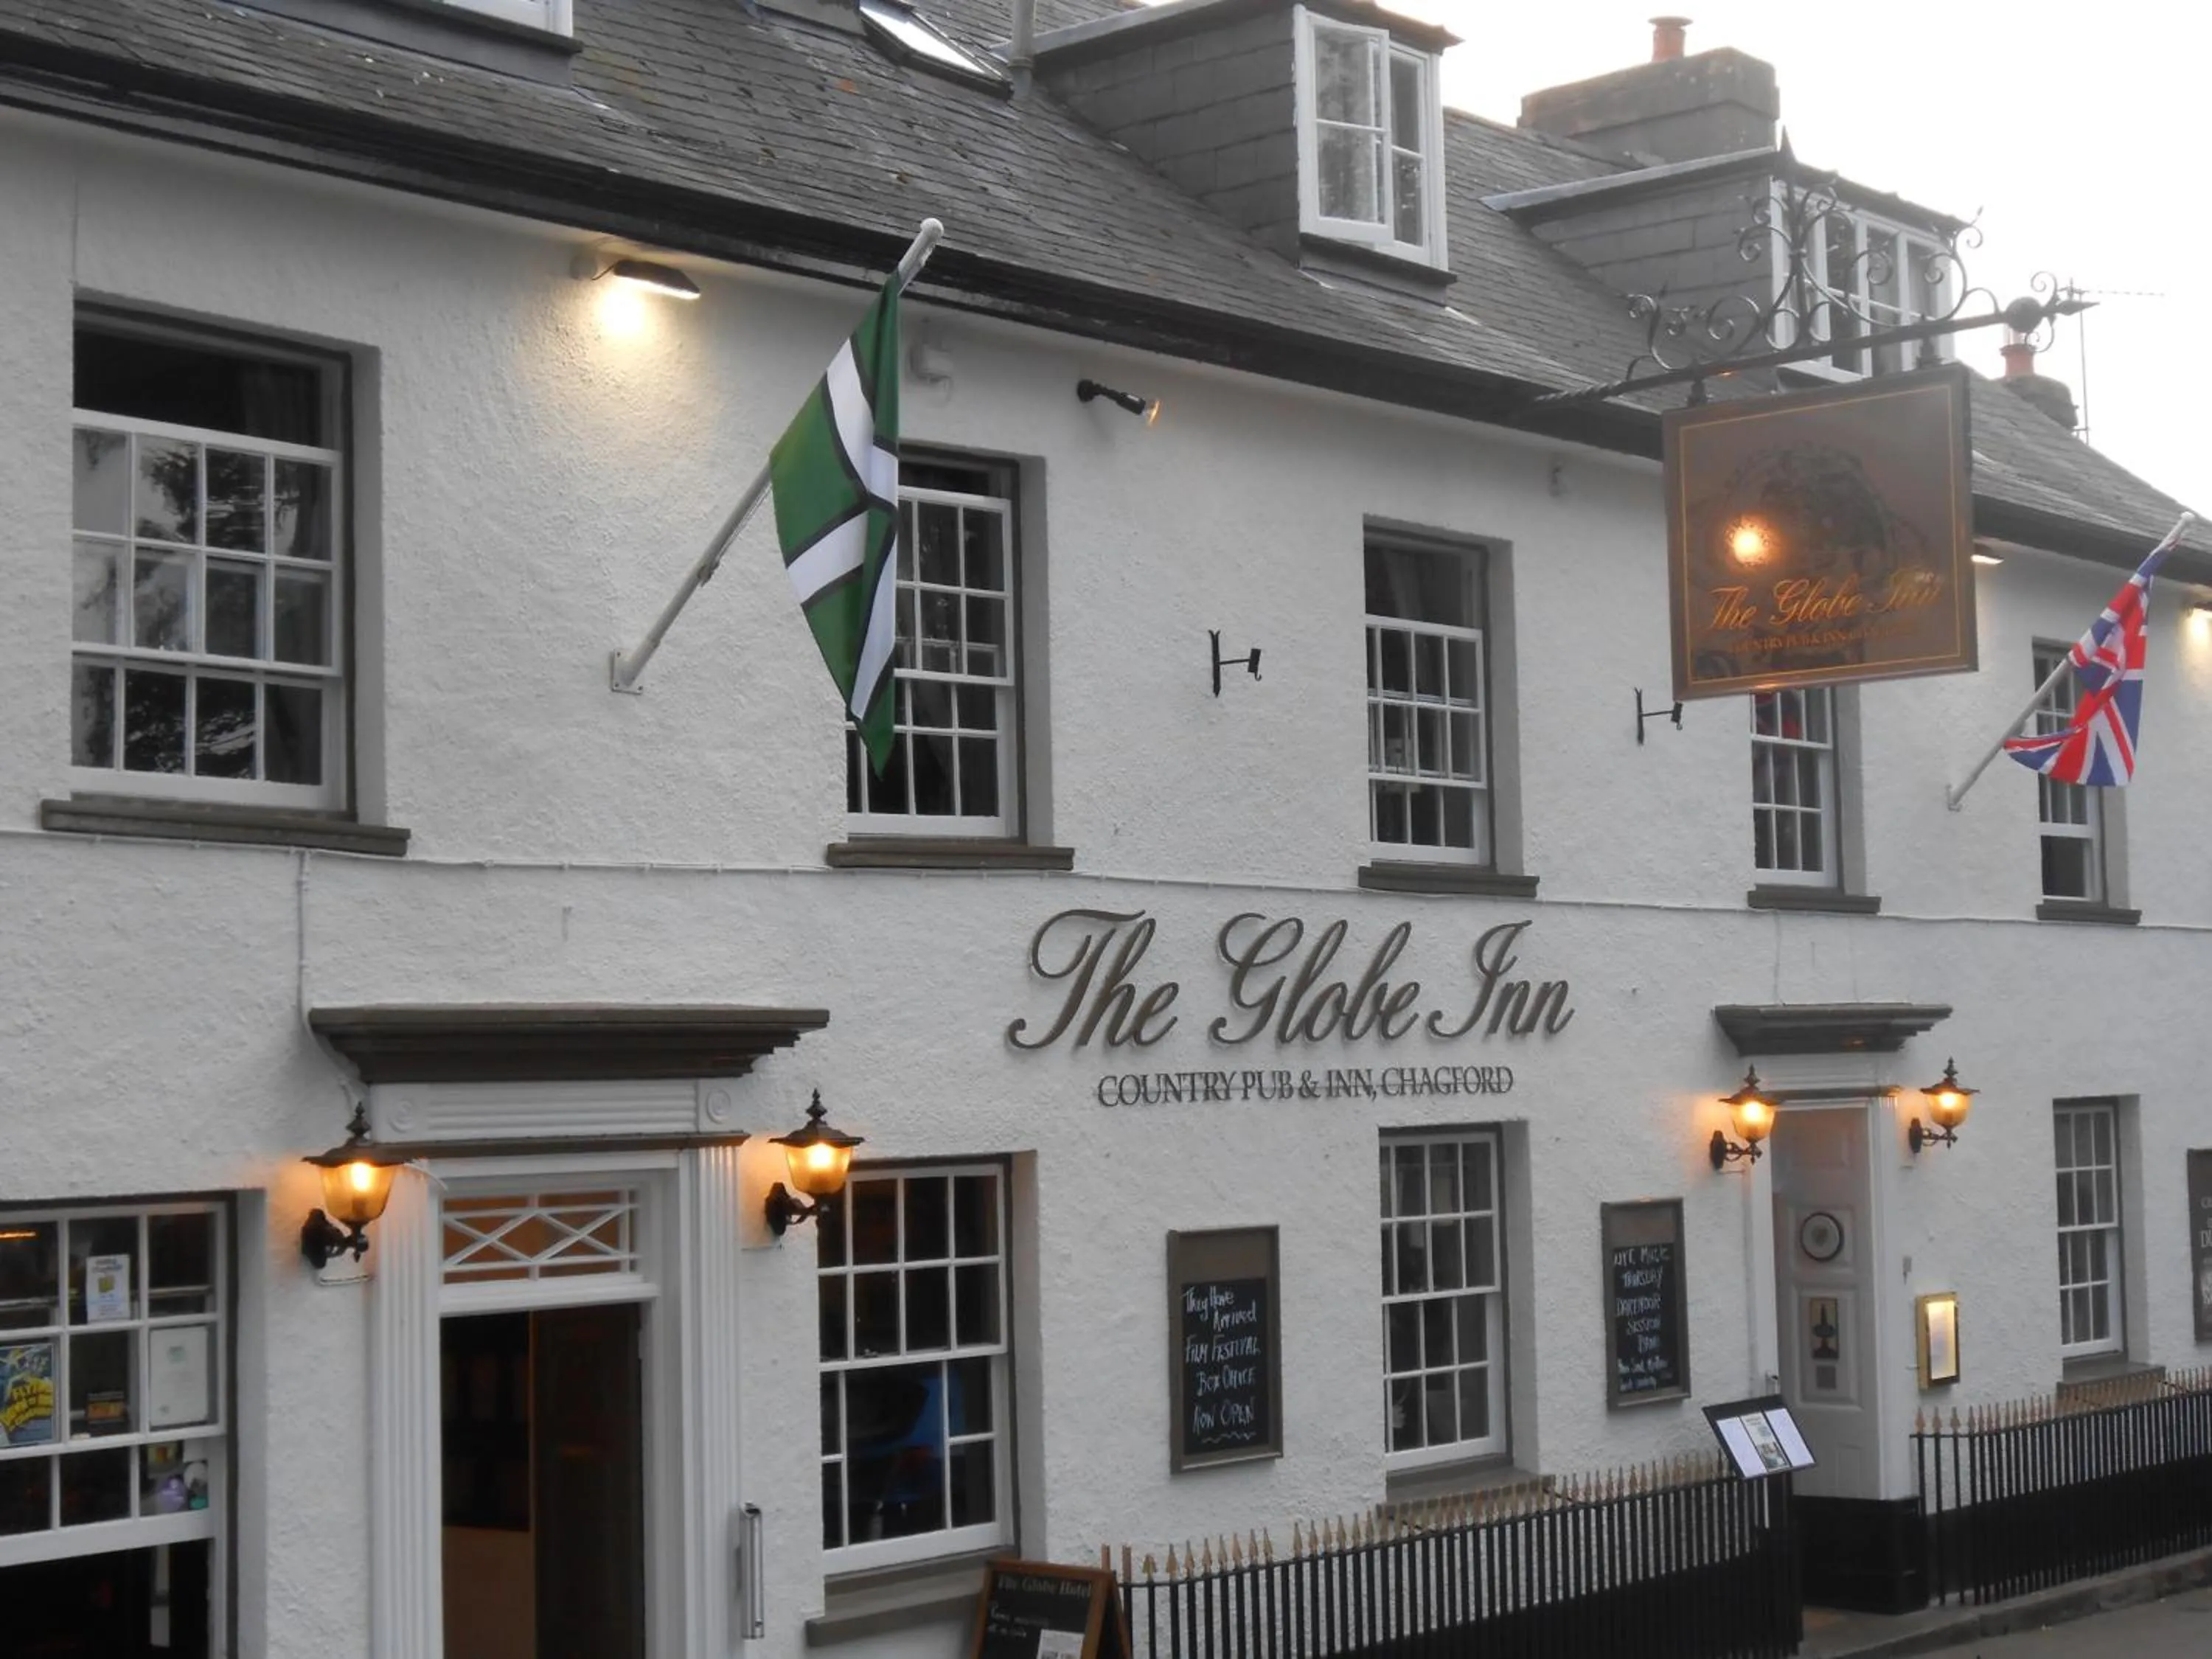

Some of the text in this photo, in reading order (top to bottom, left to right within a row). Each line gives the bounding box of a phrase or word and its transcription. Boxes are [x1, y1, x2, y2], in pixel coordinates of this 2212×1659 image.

[1700, 571, 1944, 631] The Globe Inn
[1007, 908, 1576, 1050] The Globe Inn
[1097, 1065, 1514, 1107] COUNTRY PUB & INN, CHAGFORD
